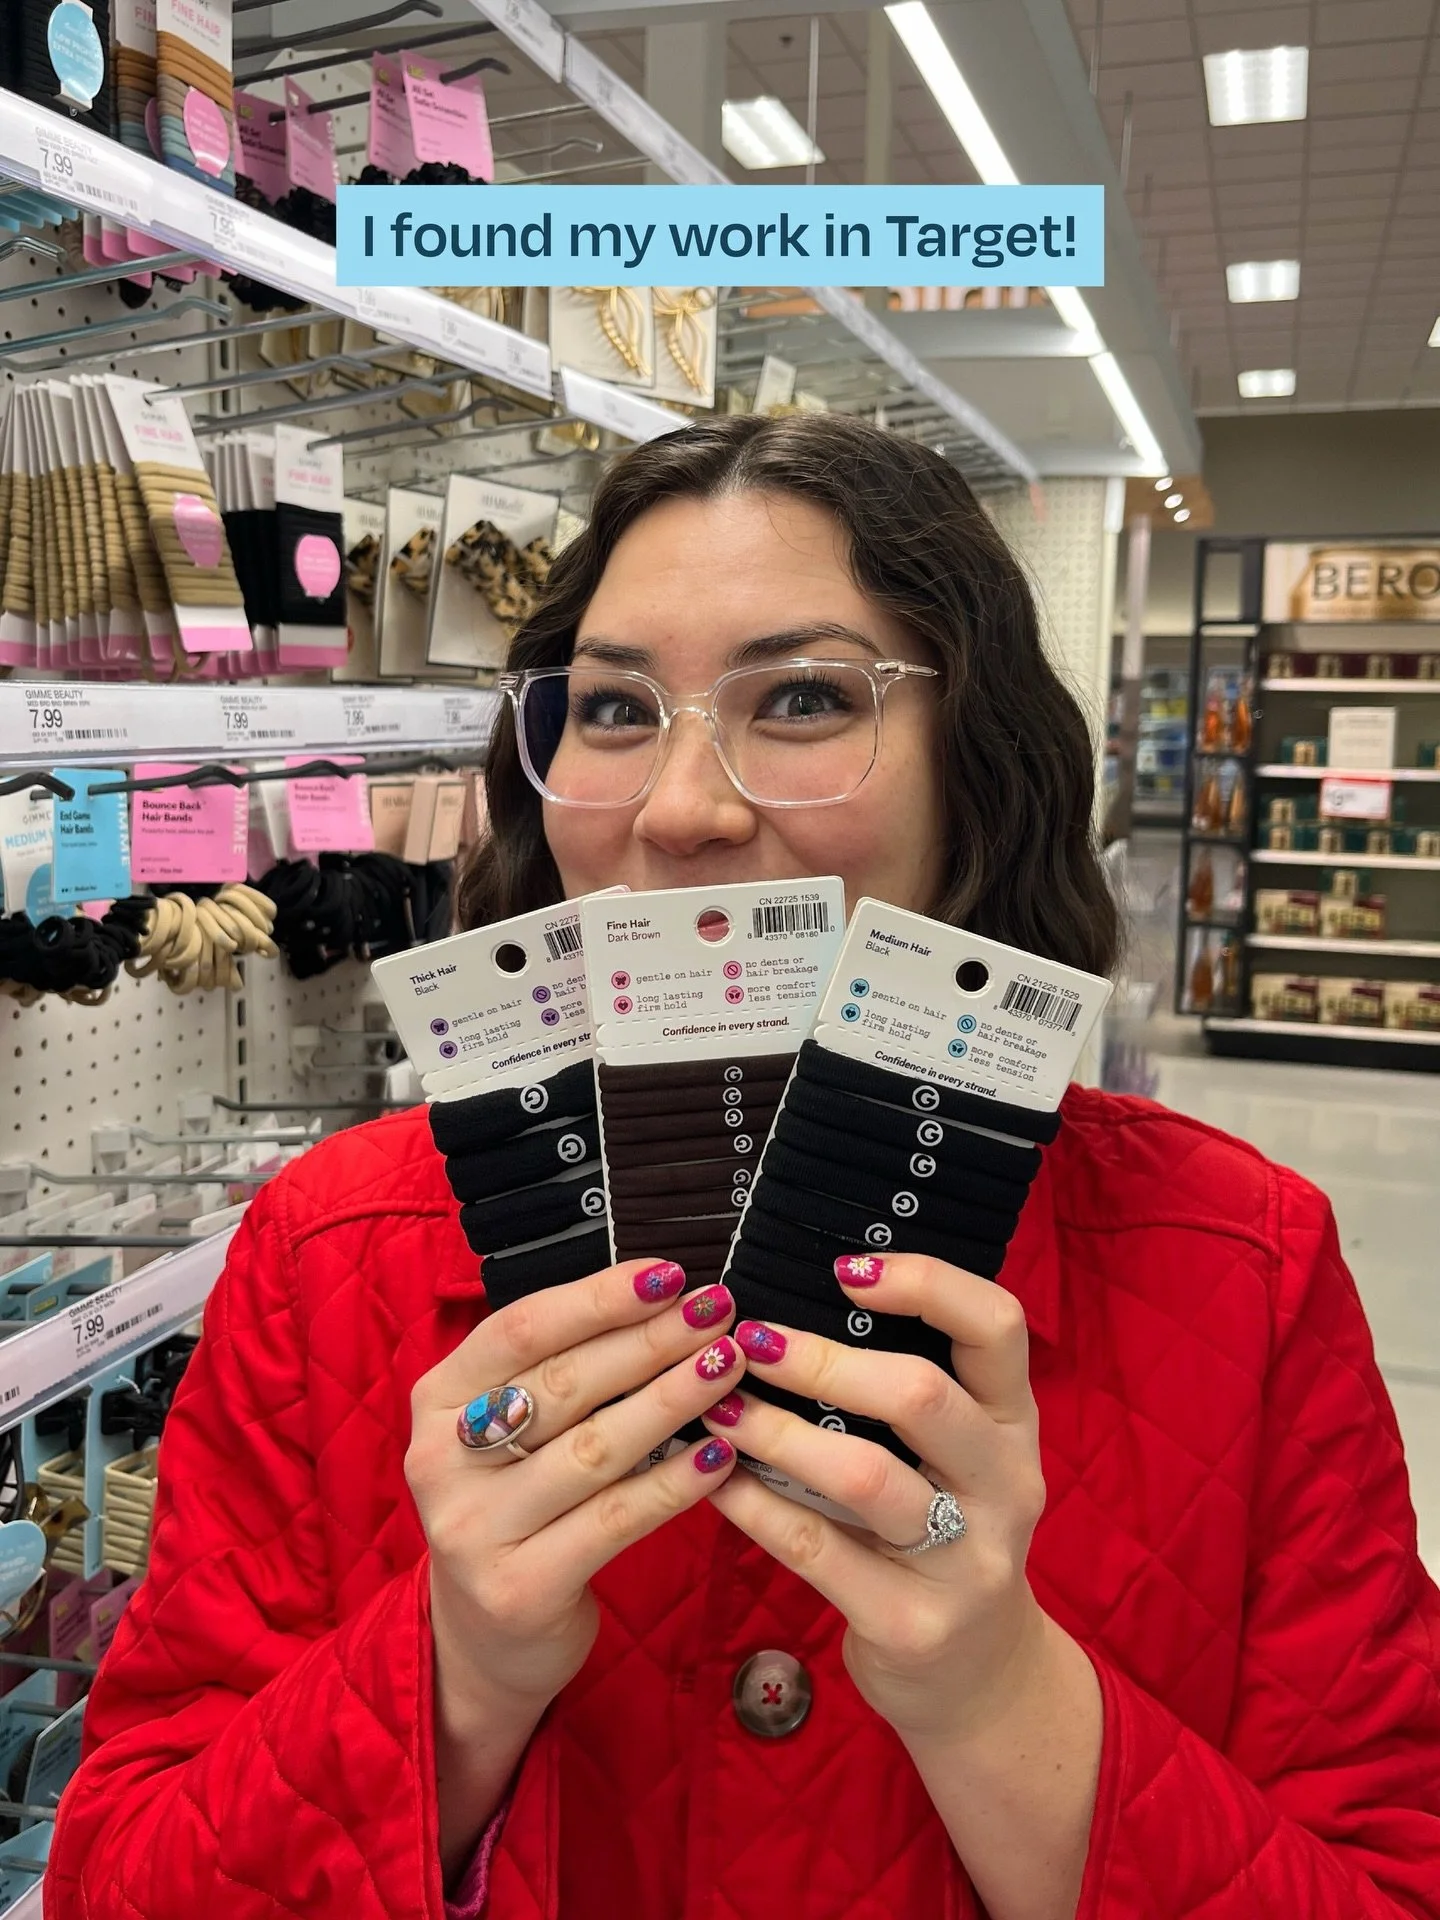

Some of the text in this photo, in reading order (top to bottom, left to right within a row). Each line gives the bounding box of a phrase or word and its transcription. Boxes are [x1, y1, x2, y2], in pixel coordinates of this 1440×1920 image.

[40, 147, 73, 177] 7.99
[1311, 561, 1440, 600] BERO
[25, 690, 83, 699] GIMME BEAUTY
[29, 709, 63, 728] 7.99
[224, 712, 249, 729] 7.99
[142, 800, 201, 810] Bounce Back
[60, 811, 72, 820] End
[142, 812, 192, 822] Hair Bands
[60, 824, 94, 834] Hair Bands
[5, 830, 47, 849] MEDIUM
[774, 895, 798, 905] 22725
[800, 893, 820, 902] 1539
[544, 914, 581, 931] CN 2272
[606, 918, 651, 930] Fine Hair
[607, 931, 661, 943] Dark Brown
[764, 933, 788, 941] 43370
[870, 929, 932, 956] Medium Hair
[865, 940, 891, 957] Black
[746, 965, 818, 977] hair breakage
[760, 958, 789, 967] dents
[409, 964, 457, 985] Thick Hair
[636, 972, 671, 984] gentle
[689, 968, 712, 978] hair
[414, 983, 440, 996] Black
[552, 982, 564, 990] no
[554, 985, 577, 998] hair
[747, 981, 816, 993] more comfort
[1017, 973, 1080, 1000] CN 21225 1529
[637, 991, 703, 1004] long lasting
[748, 990, 817, 1002] less tension
[452, 999, 522, 1027] gentle on hair
[560, 1000, 583, 1012] more
[563, 1008, 586, 1020] less
[637, 1001, 687, 1012] firm hold
[871, 990, 947, 1021] gentle on hair
[662, 1017, 790, 1037] Confidence in every strand.
[864, 1009, 931, 1039] long lasting
[1008, 1008, 1032, 1021] 43370
[1038, 1019, 1063, 1031] 07377
[459, 1019, 522, 1044] long lasting
[861, 1019, 912, 1041] firm hold
[980, 1022, 1038, 1047] no dents or
[462, 1032, 509, 1052] firm hold
[977, 1030, 1048, 1060] hair breakage
[491, 1048, 542, 1070] Confidence
[542, 1045, 552, 1053] in
[552, 1037, 577, 1051] every
[971, 1046, 1038, 1073] more comfort
[874, 1050, 997, 1098] Confidence in every strand.
[968, 1054, 1034, 1082] less tension
[95, 1286, 122, 1304] BEAUTY
[73, 1315, 104, 1344] 7.99
[804, 1487, 822, 1498] Made
